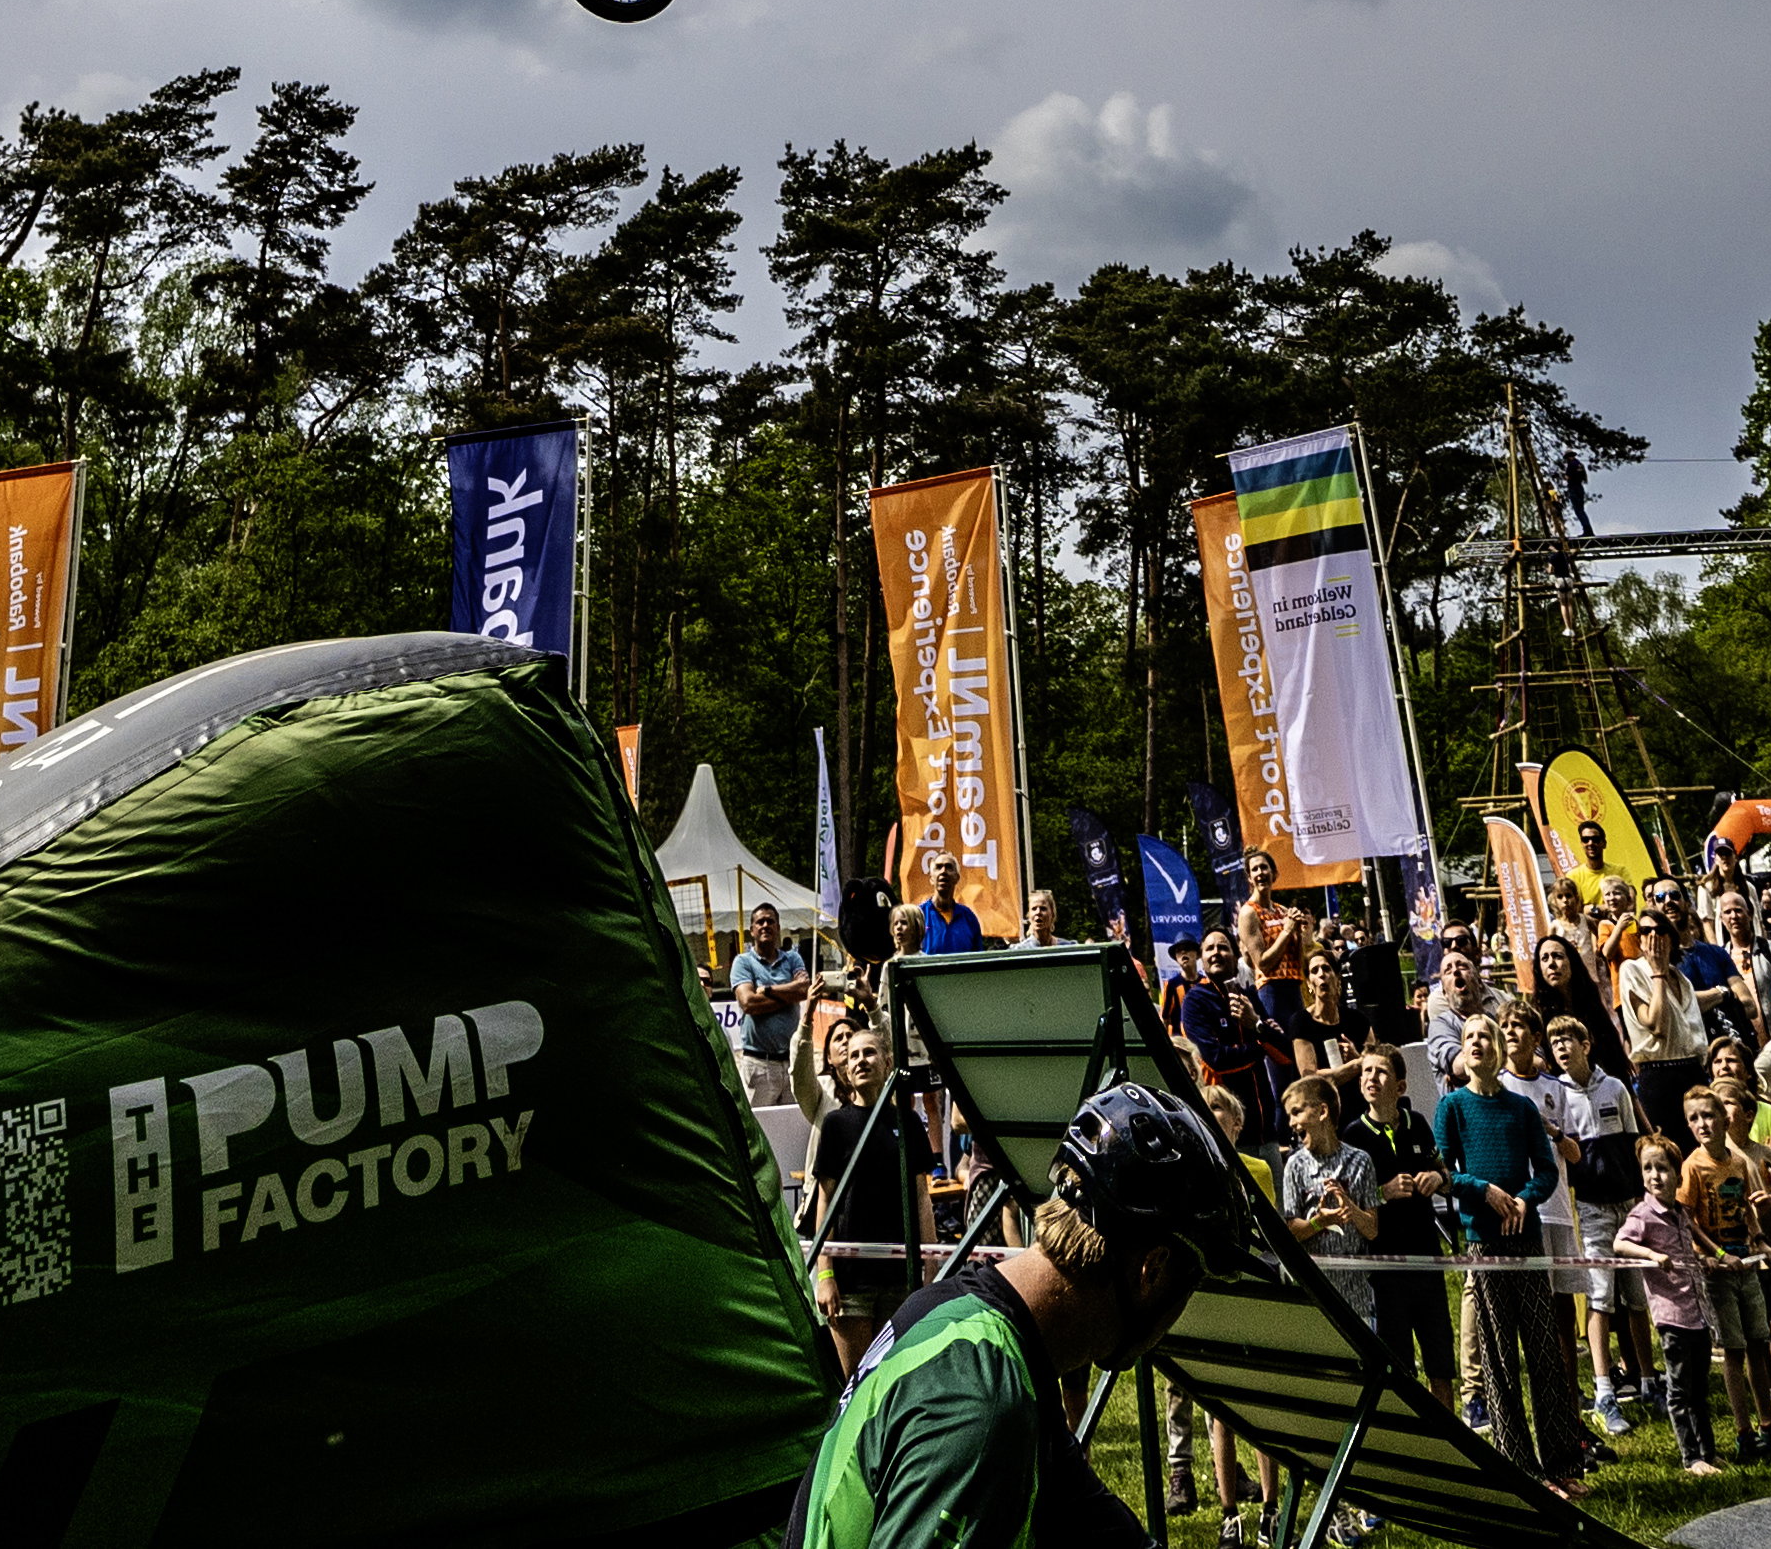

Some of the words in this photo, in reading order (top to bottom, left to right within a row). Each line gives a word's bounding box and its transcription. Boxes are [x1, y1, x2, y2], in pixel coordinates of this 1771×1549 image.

[126, 1103, 160, 1244] THE
[179, 1000, 544, 1177] PUMP
[202, 1110, 535, 1252] FACTORY
